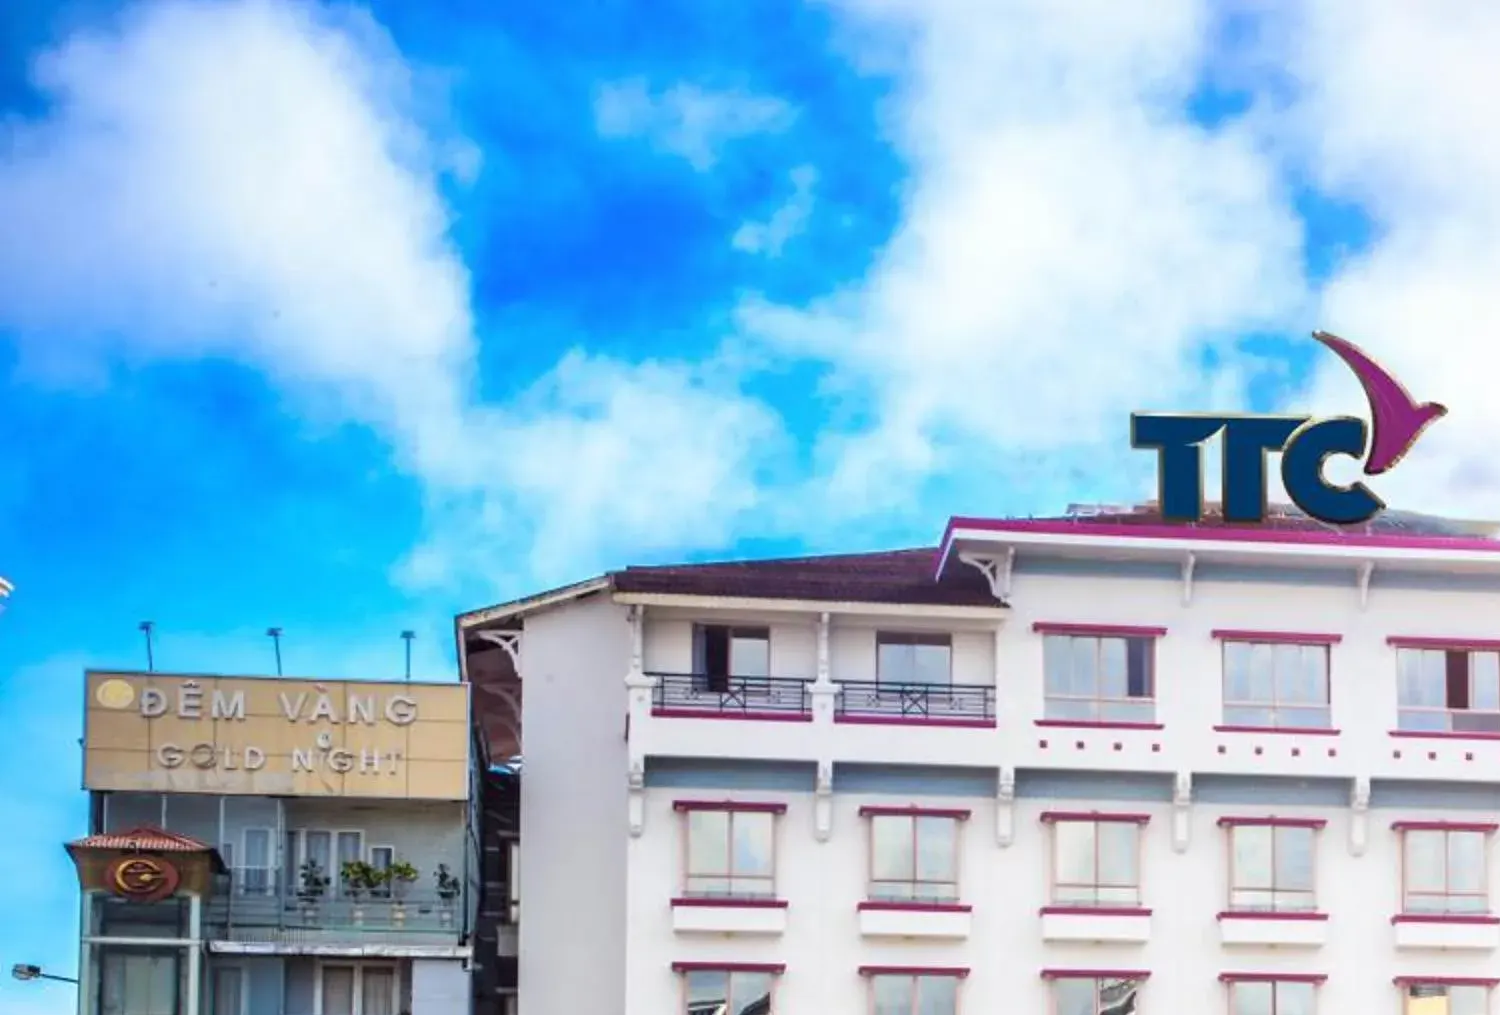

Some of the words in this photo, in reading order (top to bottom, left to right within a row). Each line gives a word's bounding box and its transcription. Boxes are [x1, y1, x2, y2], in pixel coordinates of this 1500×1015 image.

[1131, 411, 1388, 525] TTC
[139, 680, 246, 721] ĐÊM
[279, 684, 418, 727] VÀNG
[157, 742, 265, 771] GOLD
